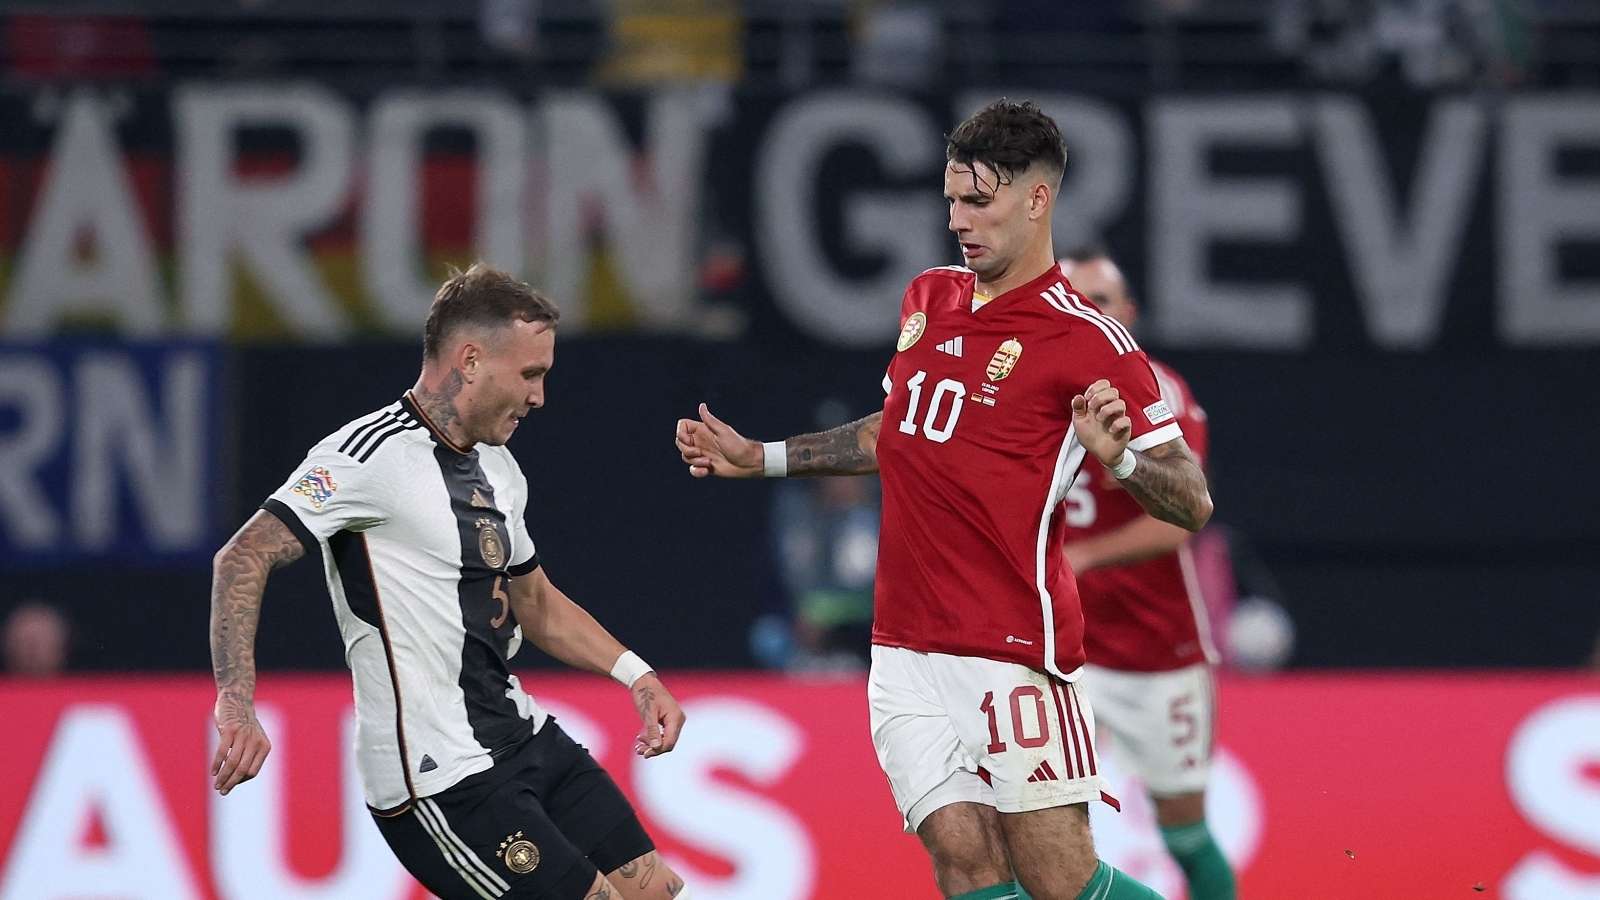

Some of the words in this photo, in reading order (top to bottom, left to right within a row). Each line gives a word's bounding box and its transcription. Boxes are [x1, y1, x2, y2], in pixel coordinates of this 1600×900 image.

[899, 370, 966, 443] 10
[489, 574, 509, 629] 5
[979, 685, 1051, 755] 10
[1167, 695, 1198, 747] 5
[0, 701, 818, 900] AUS
